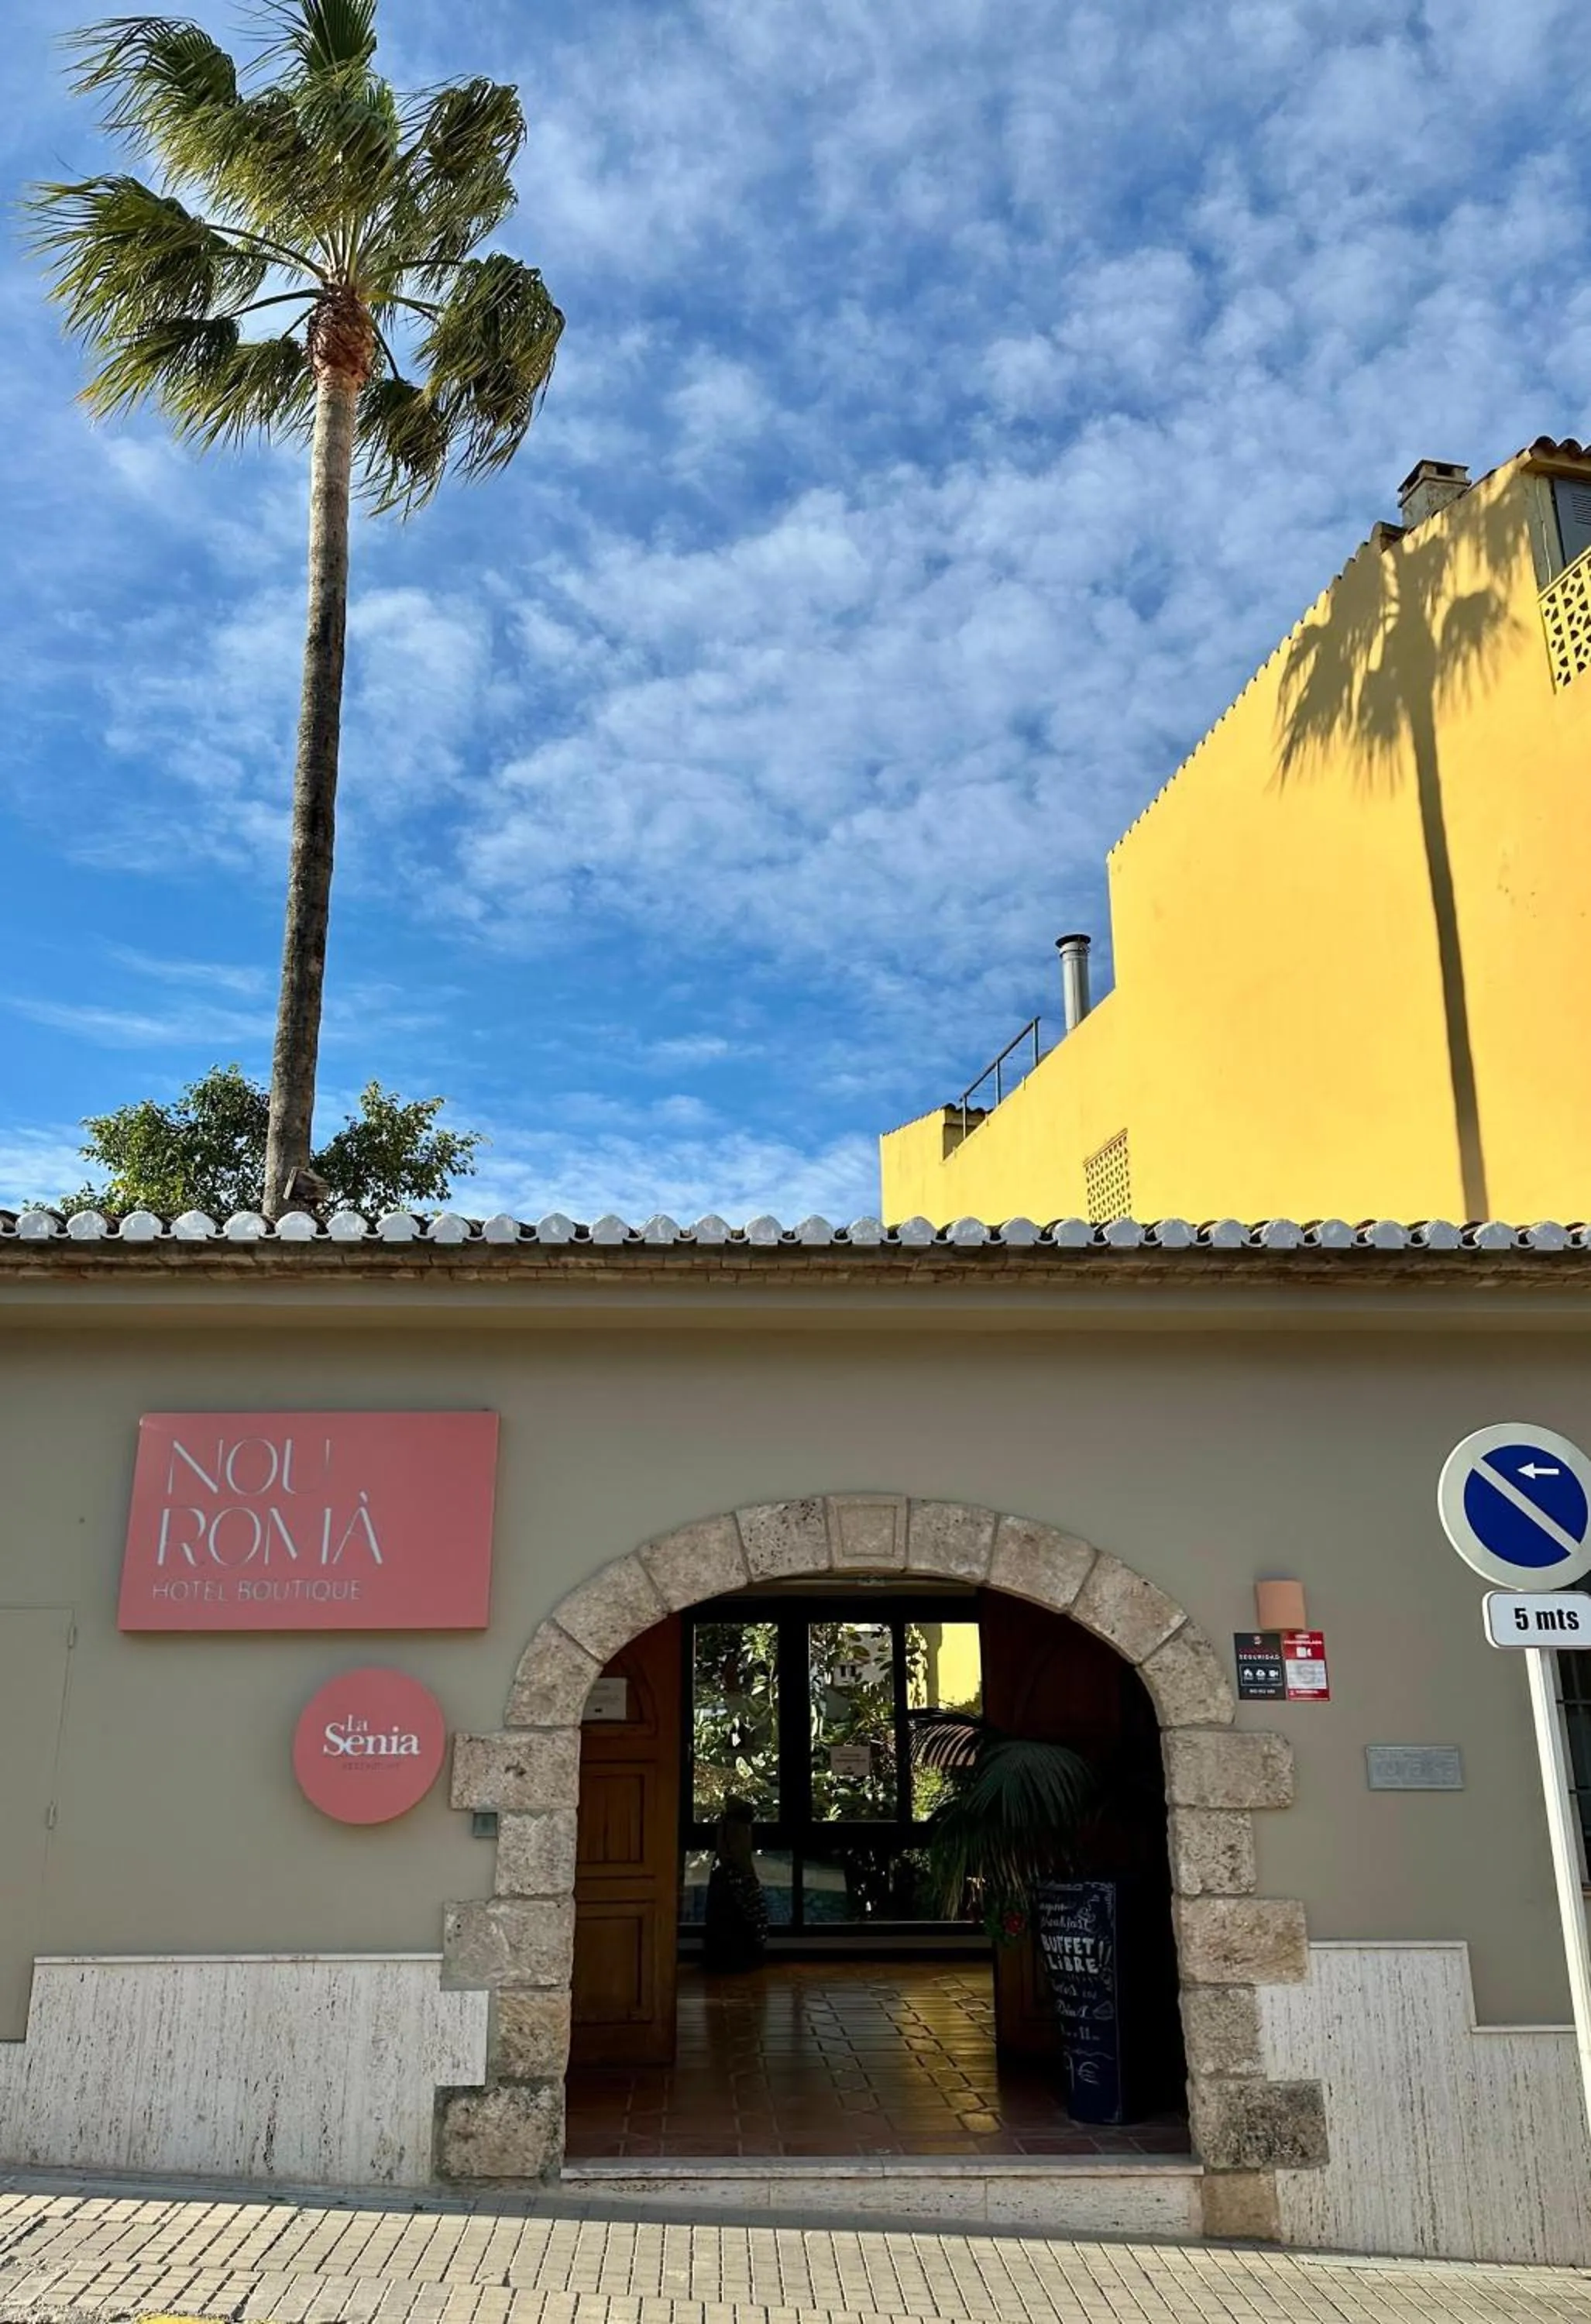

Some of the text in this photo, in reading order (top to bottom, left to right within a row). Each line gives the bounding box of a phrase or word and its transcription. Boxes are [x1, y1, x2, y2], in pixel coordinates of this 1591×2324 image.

[167, 1436, 331, 1495] NOU
[157, 1491, 383, 1566] ROMÀ
[153, 1579, 361, 1603] HOTEL BOUTIQUE
[1514, 1607, 1579, 1631] 5 mts
[1040, 1934, 1094, 1955] BUFFET
